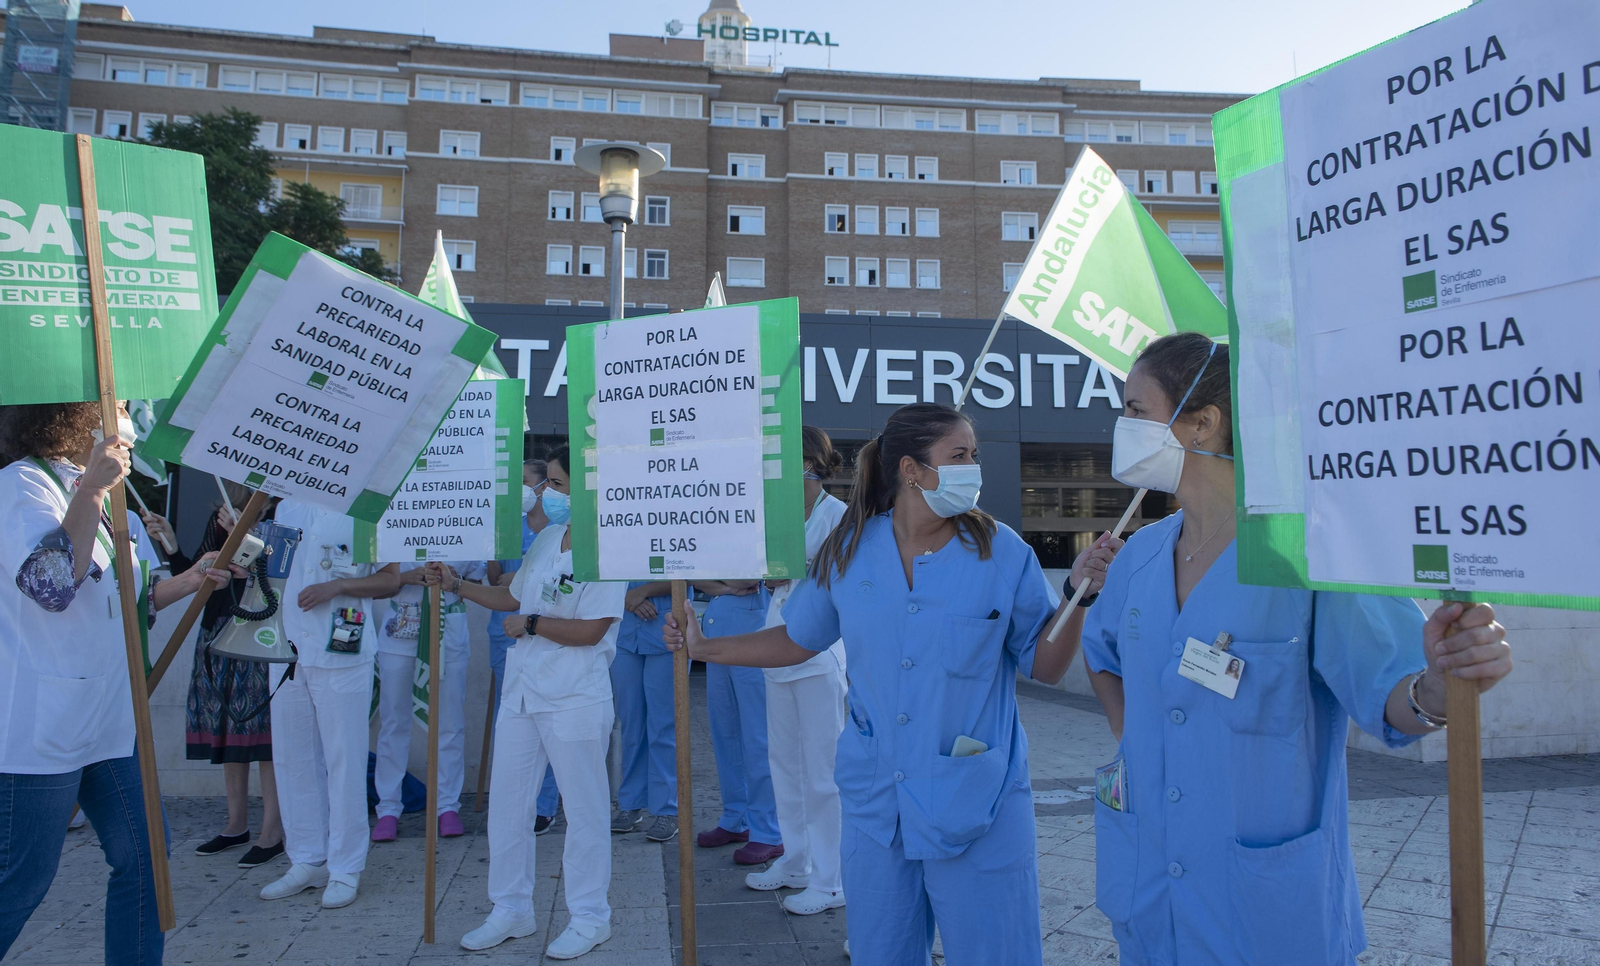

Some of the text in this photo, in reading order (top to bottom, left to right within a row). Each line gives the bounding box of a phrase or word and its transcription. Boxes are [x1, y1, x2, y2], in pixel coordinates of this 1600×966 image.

[698, 24, 839, 46] HOSPITAL
[1387, 35, 1506, 104] POR LA
[1307, 72, 1565, 186] CONTRATACIÓN
[1296, 126, 1592, 242] LARGA DURACIÓN
[1018, 164, 1112, 319] Andalucía
[1404, 212, 1510, 266] EL SAS
[150, 272, 180, 285] DE
[1440, 268, 1482, 284] Sindicato
[1441, 287, 1452, 296] de
[1442, 297, 1460, 306] Sevilla
[341, 286, 424, 332] CONTRA LA
[1406, 296, 1435, 309] SATSE
[30, 314, 162, 328] SEVLLA
[316, 302, 422, 356] PRECARIEDAD
[1072, 290, 1160, 357] SAT
[646, 326, 698, 346] POR LA
[1400, 317, 1524, 362] POR LA
[297, 322, 412, 379] LABORAL EN LA
[271, 338, 409, 402] SANIDAD PÚBLICA
[604, 349, 746, 376] CONTRATACIÓN DE
[598, 375, 755, 403] LARGA DURACIÓN EN
[1318, 367, 1583, 427] CONTRATACIÓN
[275, 392, 361, 432] CONTRA LA
[460, 409, 474, 418] EN
[478, 408, 491, 418] LA
[652, 408, 696, 424] EL SAS
[250, 408, 358, 454] PRECARIEDAD
[438, 426, 484, 438] PÚBLICA
[232, 426, 350, 476] LABORAL EN LA
[1308, 430, 1600, 480] LARGA DURACIÓN
[207, 442, 347, 497] SANIDAD PÚBLICA
[648, 458, 699, 474] POR LA
[406, 482, 418, 492] LA
[422, 480, 491, 492] ESTABILIDAD
[606, 480, 746, 501] CONTRATACIÓN DE
[398, 500, 408, 510] EL
[412, 500, 455, 510] EMPLEO
[459, 499, 472, 508] EN
[476, 498, 490, 508] LA
[386, 515, 484, 528] SANIDAD PÚBLICA
[600, 506, 756, 527] LARGA DURACIÓN EN
[1415, 504, 1528, 536] EL SAS
[404, 536, 463, 546] ANDALUZA
[650, 538, 697, 552] EL SAS
[1453, 553, 1498, 564] Sindicato
[1416, 570, 1448, 580] SATSE
[1454, 566, 1466, 576] de
[1454, 578, 1476, 586] Sevilla
